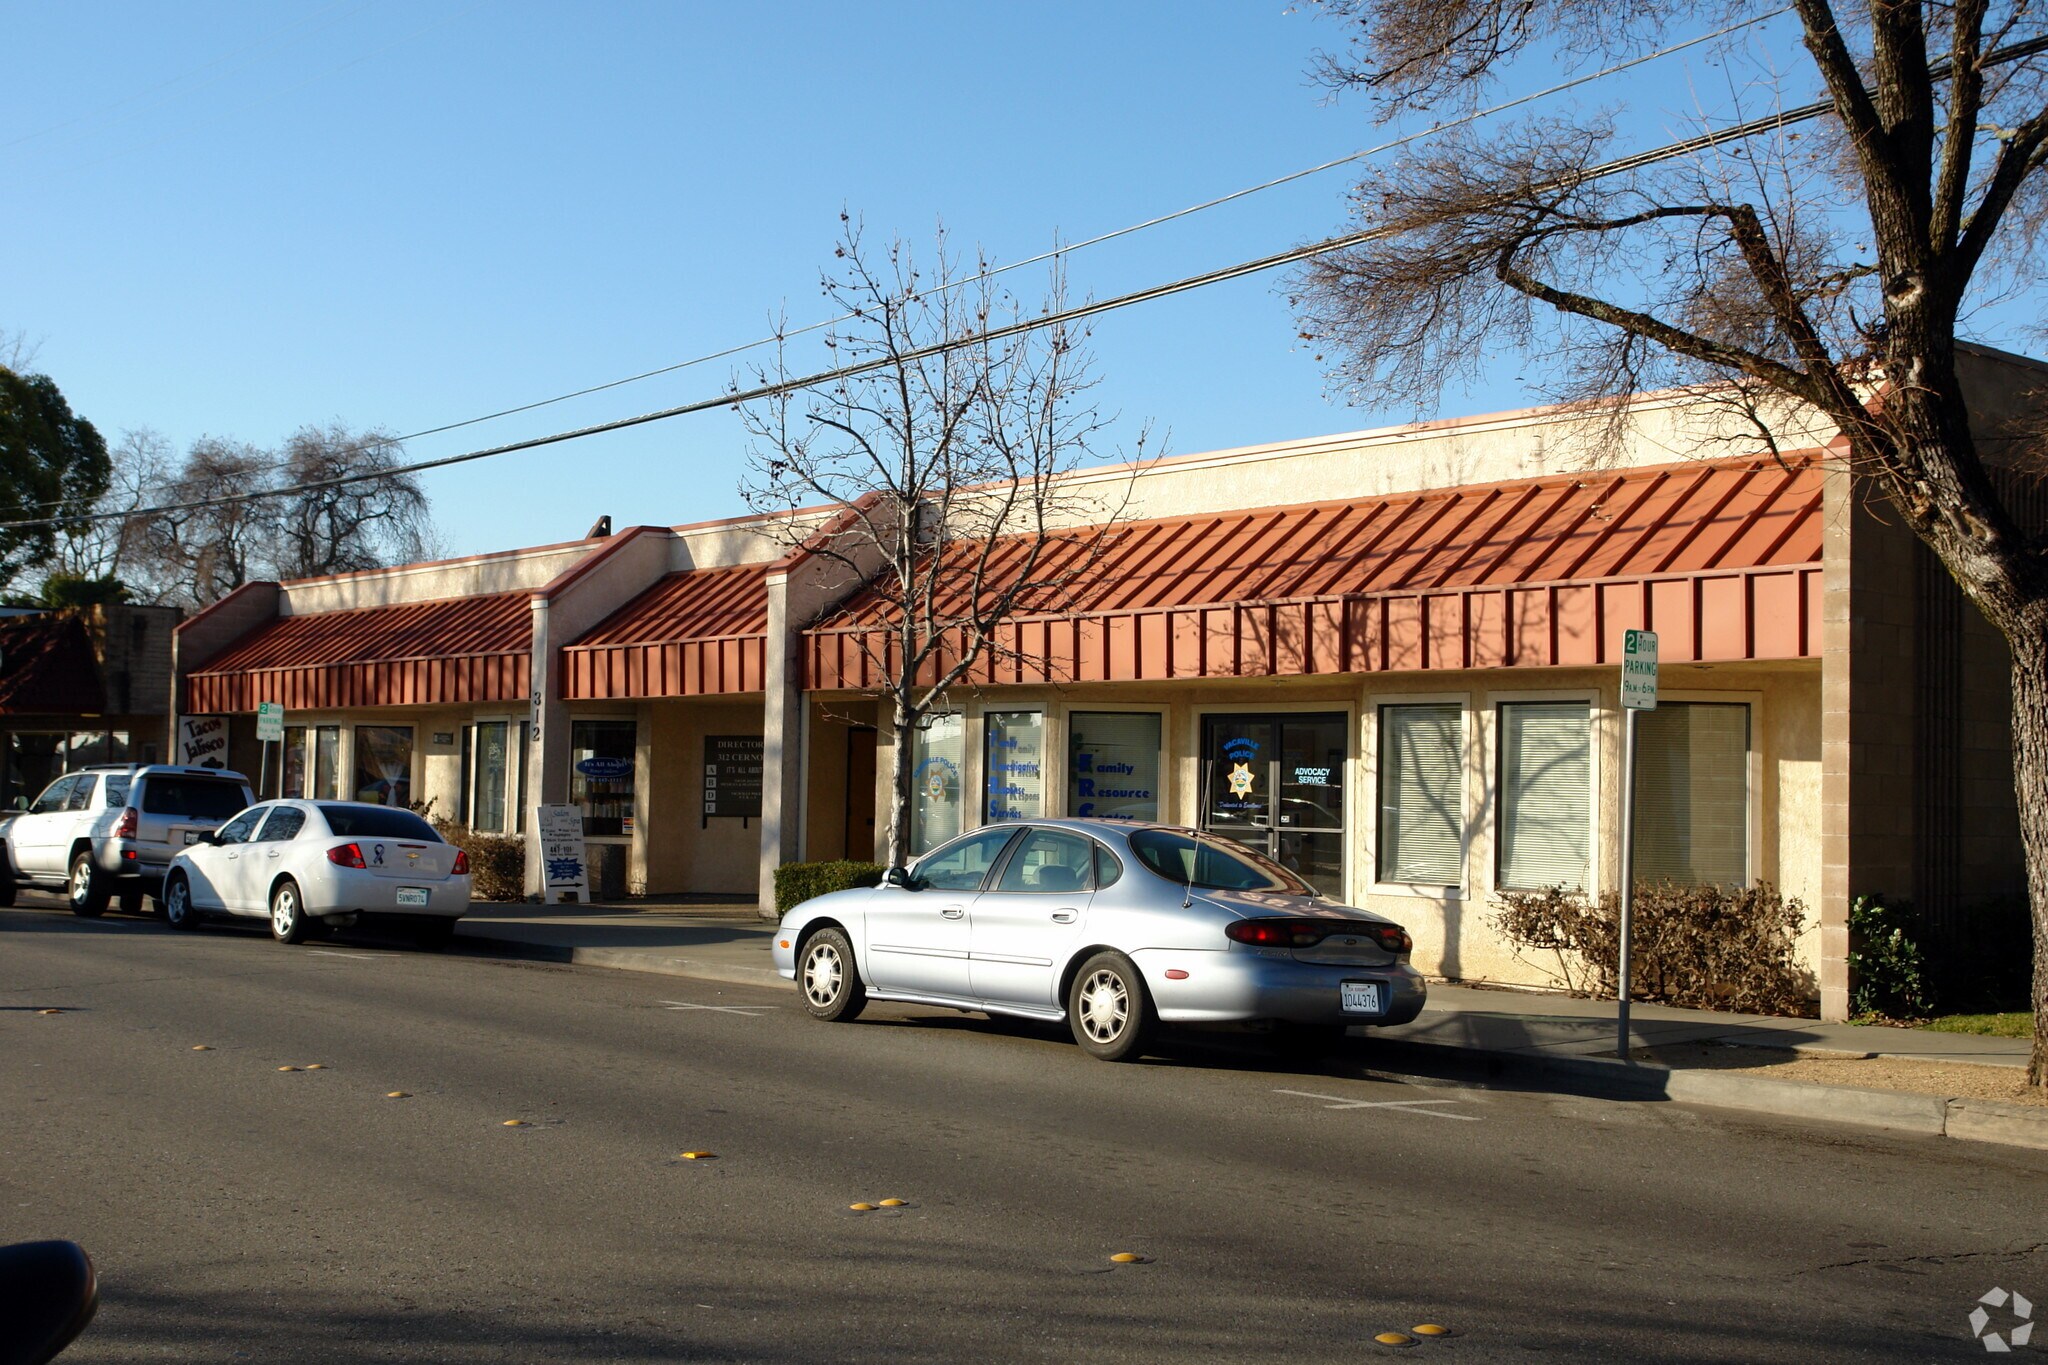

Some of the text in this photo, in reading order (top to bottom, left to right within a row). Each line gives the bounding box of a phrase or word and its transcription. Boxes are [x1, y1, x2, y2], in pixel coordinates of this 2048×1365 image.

[1627, 634, 1656, 653] 2 HOUR
[1625, 660, 1656, 676] PARKING
[261, 704, 267, 713] 2
[184, 718, 222, 738] Tacos
[183, 737, 225, 764] Jalisco
[1223, 738, 1260, 750] VACAVILLE
[1229, 750, 1254, 759] POLICE
[1295, 768, 1330, 776] ADVOCACY
[1298, 776, 1327, 784] SERVICE
[1078, 778, 1150, 798] Resource
[1344, 993, 1377, 1008] 1044376
